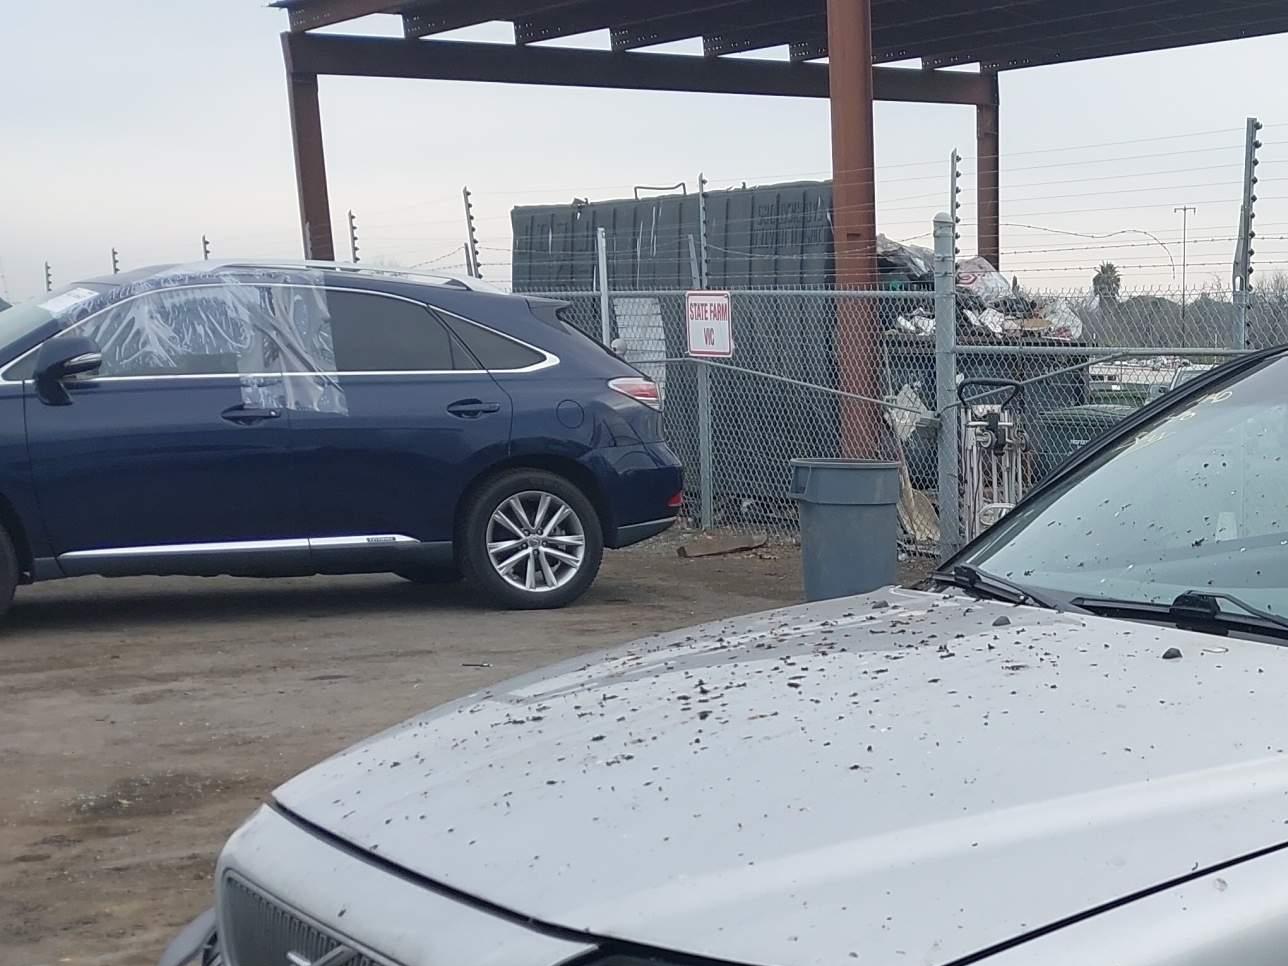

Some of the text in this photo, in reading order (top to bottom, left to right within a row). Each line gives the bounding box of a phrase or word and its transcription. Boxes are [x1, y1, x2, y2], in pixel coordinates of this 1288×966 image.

[690, 303, 727, 320] STATE FARM
[704, 328, 714, 345] VIC
